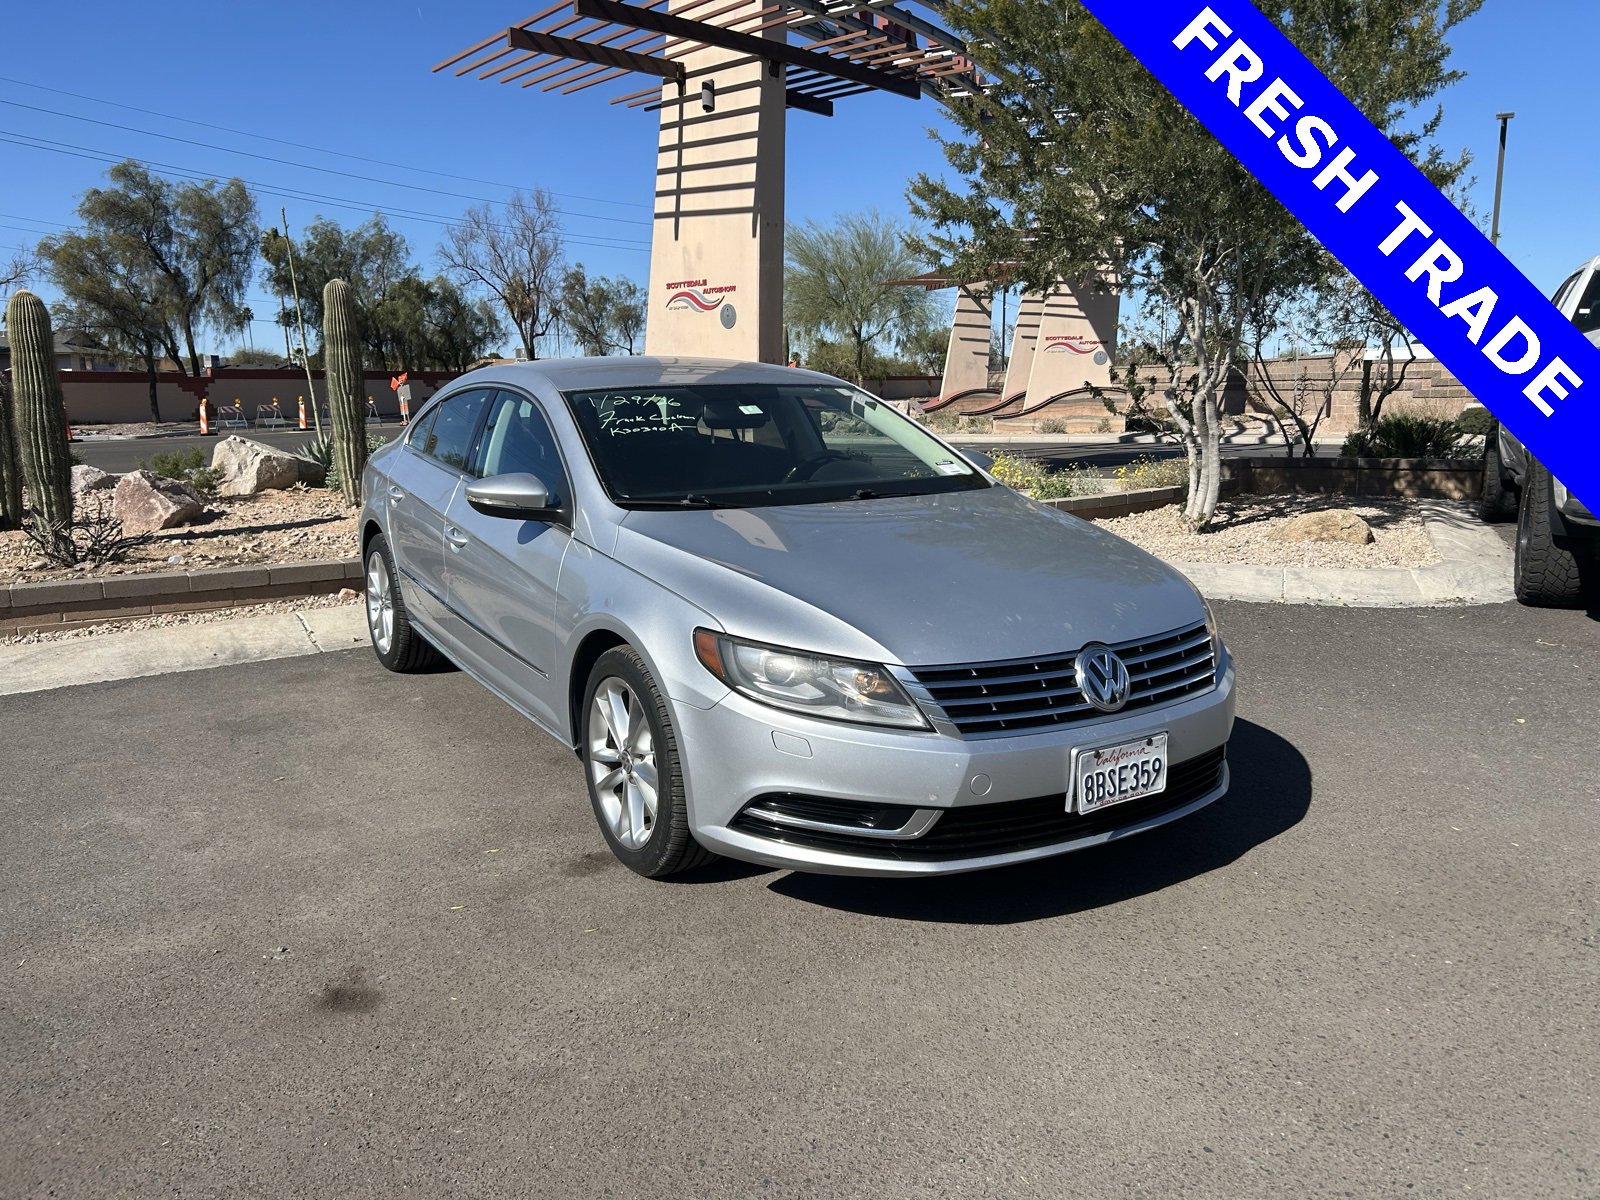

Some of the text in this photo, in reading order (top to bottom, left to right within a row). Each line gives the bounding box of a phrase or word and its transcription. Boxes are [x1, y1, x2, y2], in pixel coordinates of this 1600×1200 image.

[666, 279, 707, 289] SCOTTSDALE
[702, 285, 737, 295] AUTOSHOW
[1095, 746, 1150, 766] California
[1084, 757, 1162, 804] 8BSE359
